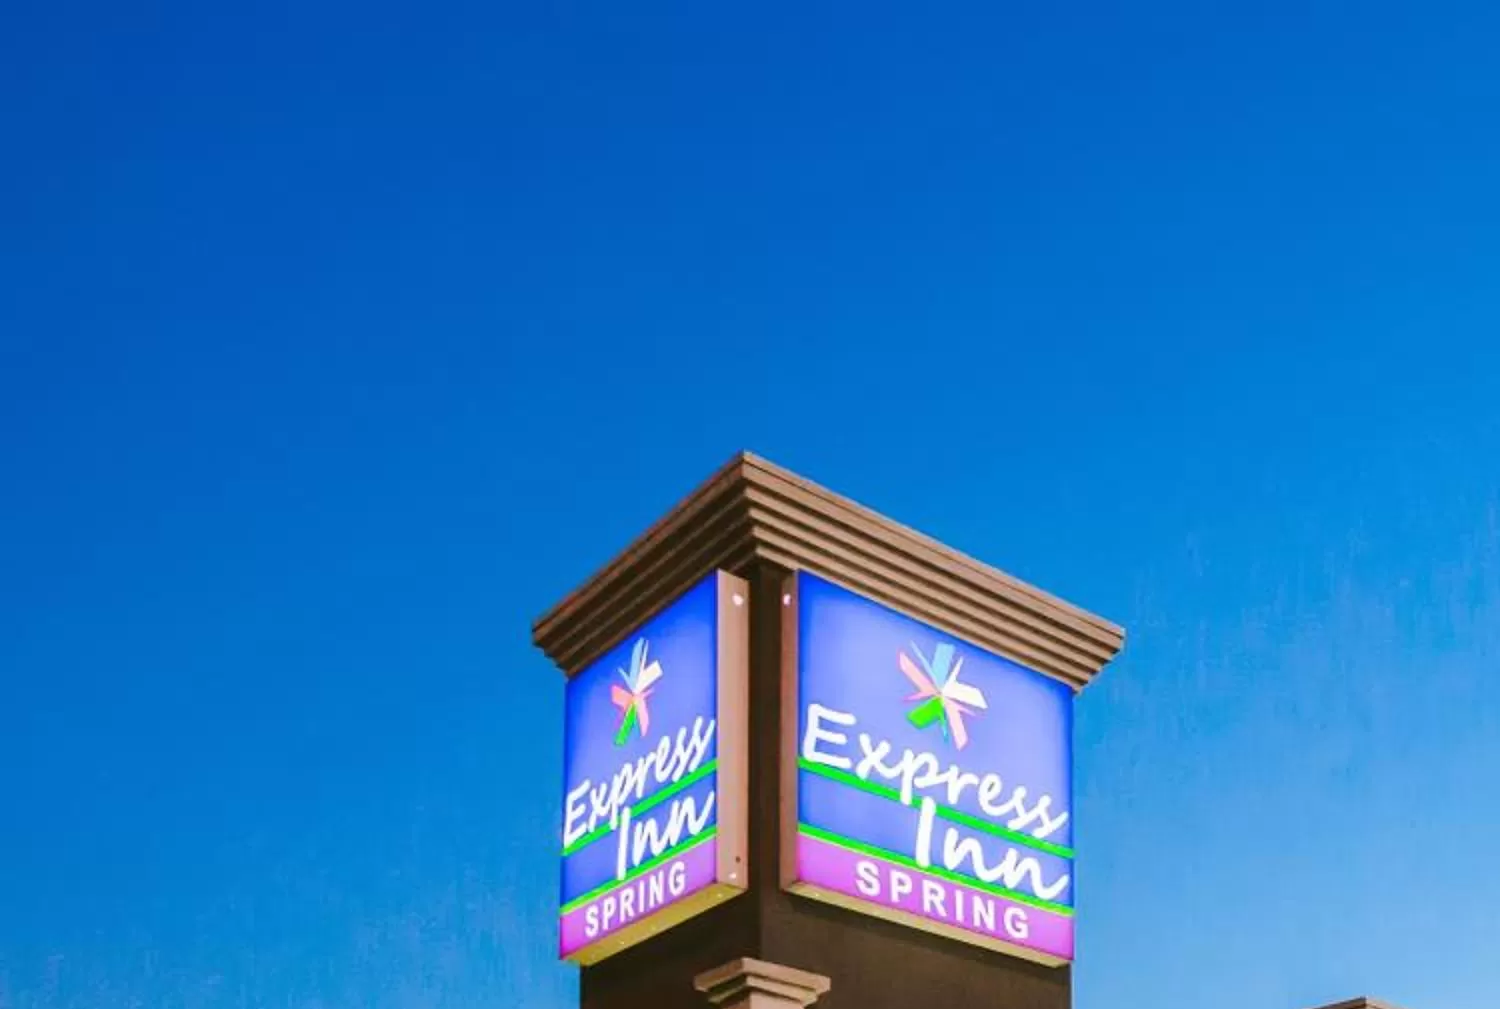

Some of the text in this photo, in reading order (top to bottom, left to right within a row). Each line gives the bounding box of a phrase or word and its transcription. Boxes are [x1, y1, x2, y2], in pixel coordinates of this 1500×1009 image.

[562, 715, 716, 848] Express
[802, 703, 1069, 838] Express
[616, 790, 716, 881] Inn
[915, 796, 1069, 900] Inn
[584, 861, 686, 938] SPRING
[855, 860, 1030, 939] SPRING
